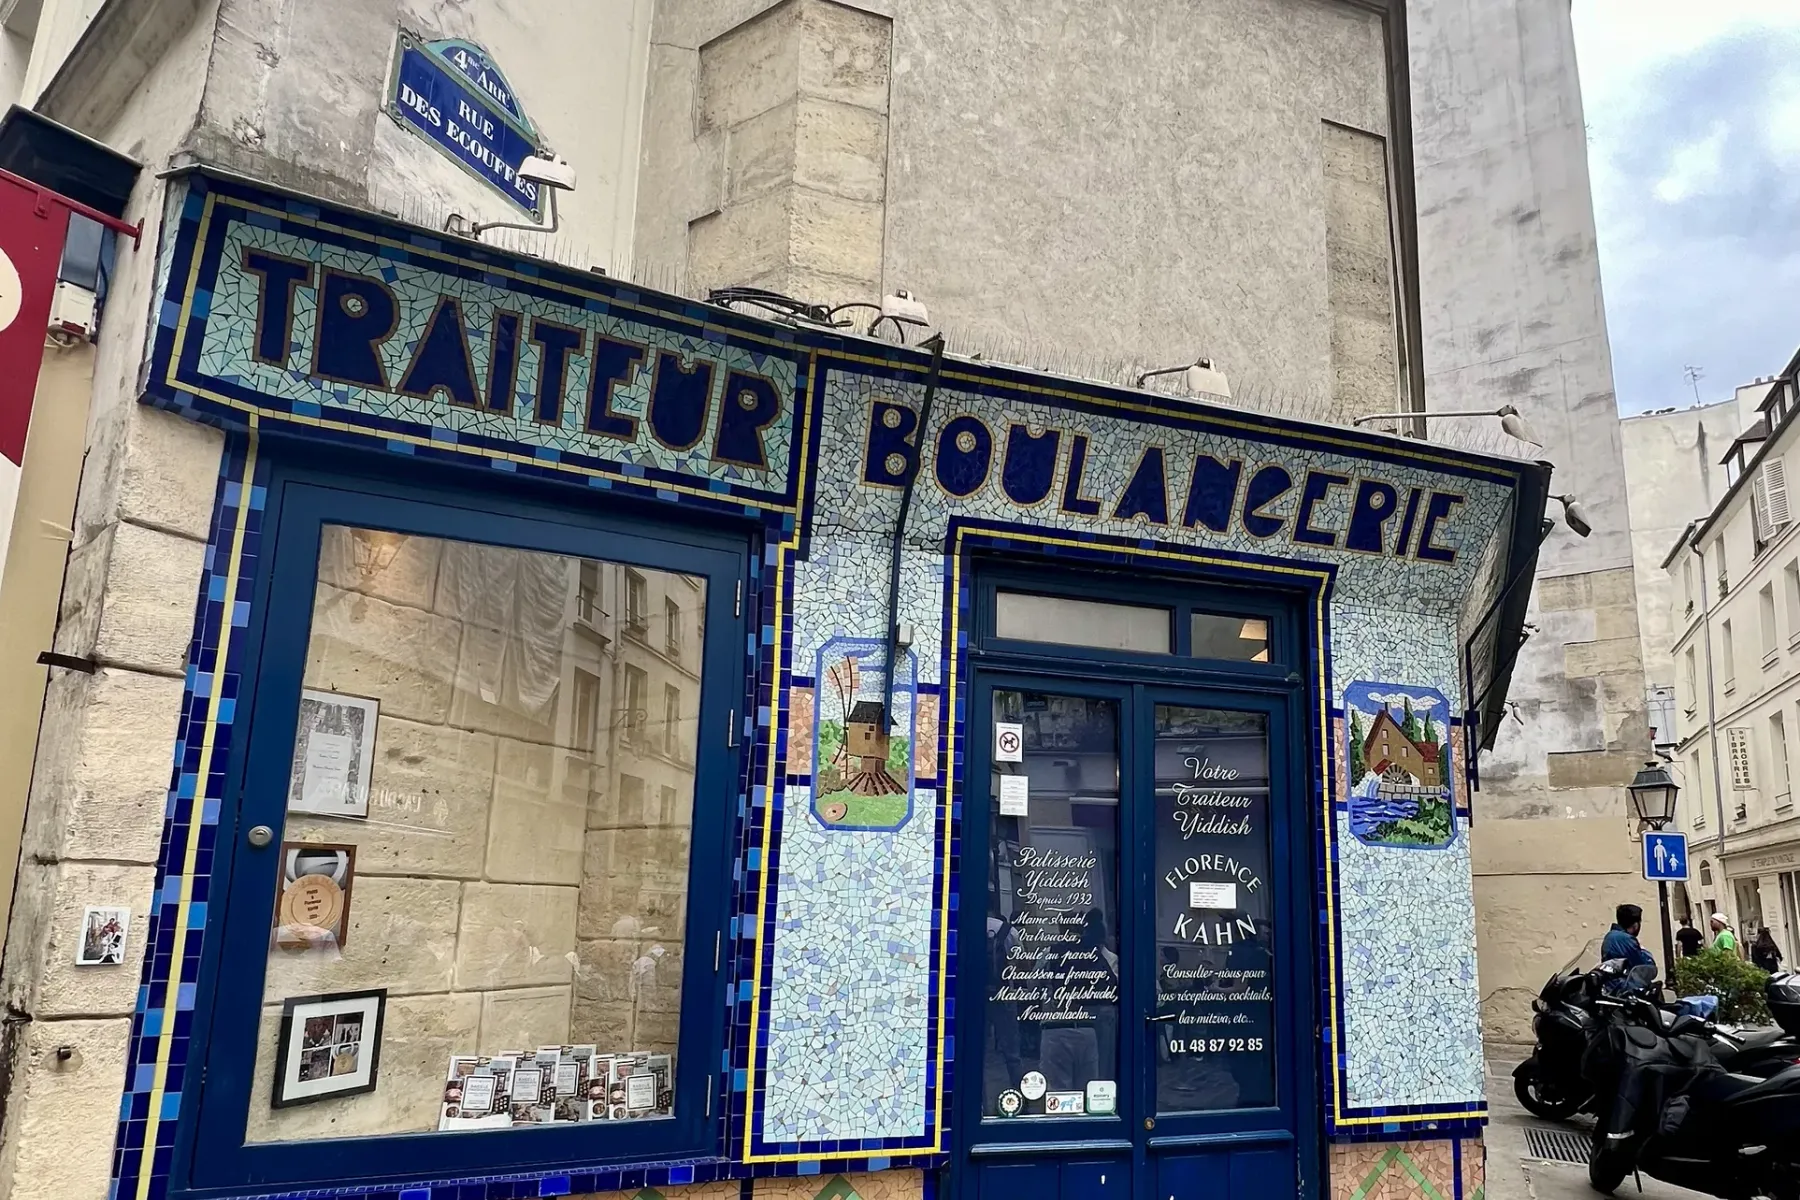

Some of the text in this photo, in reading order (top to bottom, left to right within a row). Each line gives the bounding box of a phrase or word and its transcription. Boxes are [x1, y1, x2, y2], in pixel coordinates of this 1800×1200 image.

[458, 99, 494, 140] RUE
[401, 83, 537, 201] DES ECOUFFES
[241, 246, 784, 471] TRAITEUR
[859, 397, 1465, 565] BOULANGERIE
[1184, 757, 1240, 780] Votre
[1730, 729, 1741, 784] LIBRAIRIE
[1172, 783, 1253, 808] Traiteur
[1172, 810, 1253, 840] Yiddish
[1016, 870, 1090, 897] Yiddish
[1165, 854, 1262, 894] FLORENCE
[1025, 892, 1092, 909] Depuis 1932
[1011, 911, 1089, 928] Mame strudel,
[1173, 913, 1257, 946] KAHN
[1045, 952, 1059, 960] au
[1060, 946, 1099, 967] pavot,
[1001, 965, 1054, 980] Chausson
[1064, 965, 1110, 985] fromage,
[1241, 969, 1266, 983] pour
[1053, 985, 1118, 1008] Apfelstrudel,
[1158, 986, 1273, 1006] vos réceptions, cocktails,
[1178, 1009, 1196, 1024] bar
[1170, 1038, 1263, 1053] 01 48 87 92 85
